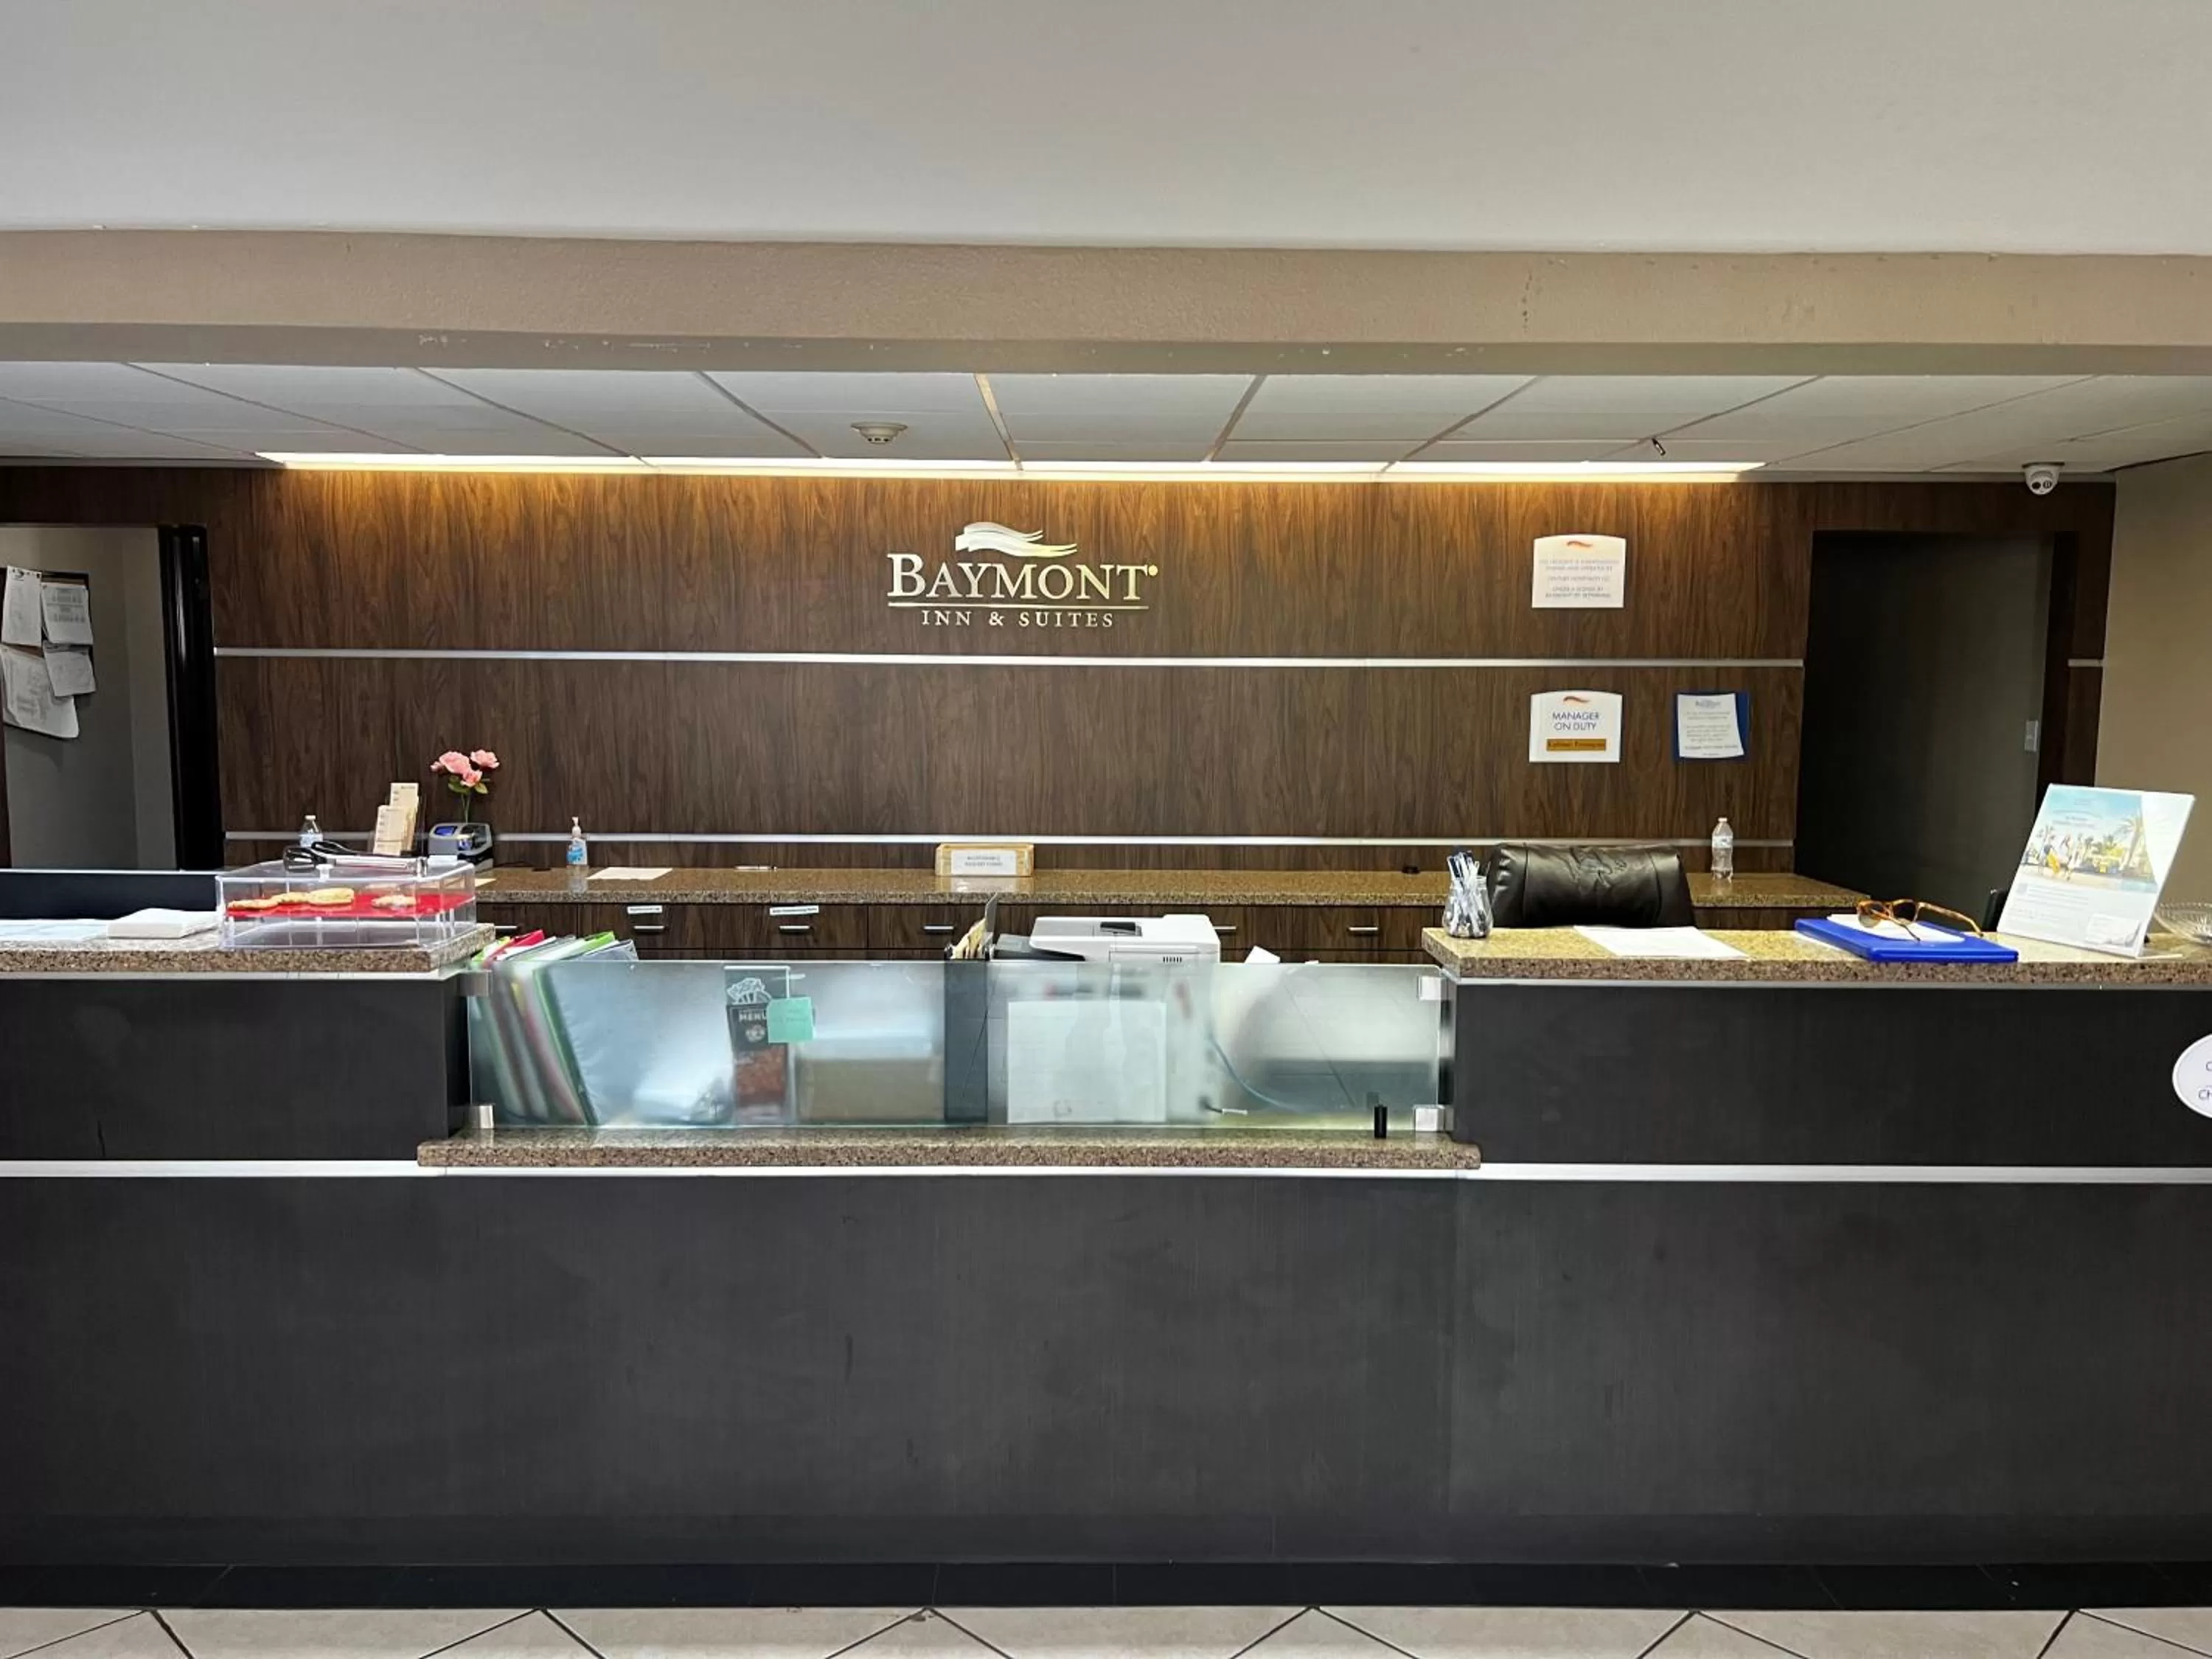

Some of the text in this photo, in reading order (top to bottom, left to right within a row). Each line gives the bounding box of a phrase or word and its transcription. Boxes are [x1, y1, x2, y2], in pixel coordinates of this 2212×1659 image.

[887, 553, 1149, 601] BAYMONT
[922, 610, 1113, 627] INN & SUITES
[1552, 712, 1599, 720] MANAGER
[1554, 722, 1596, 731] ON DUTY
